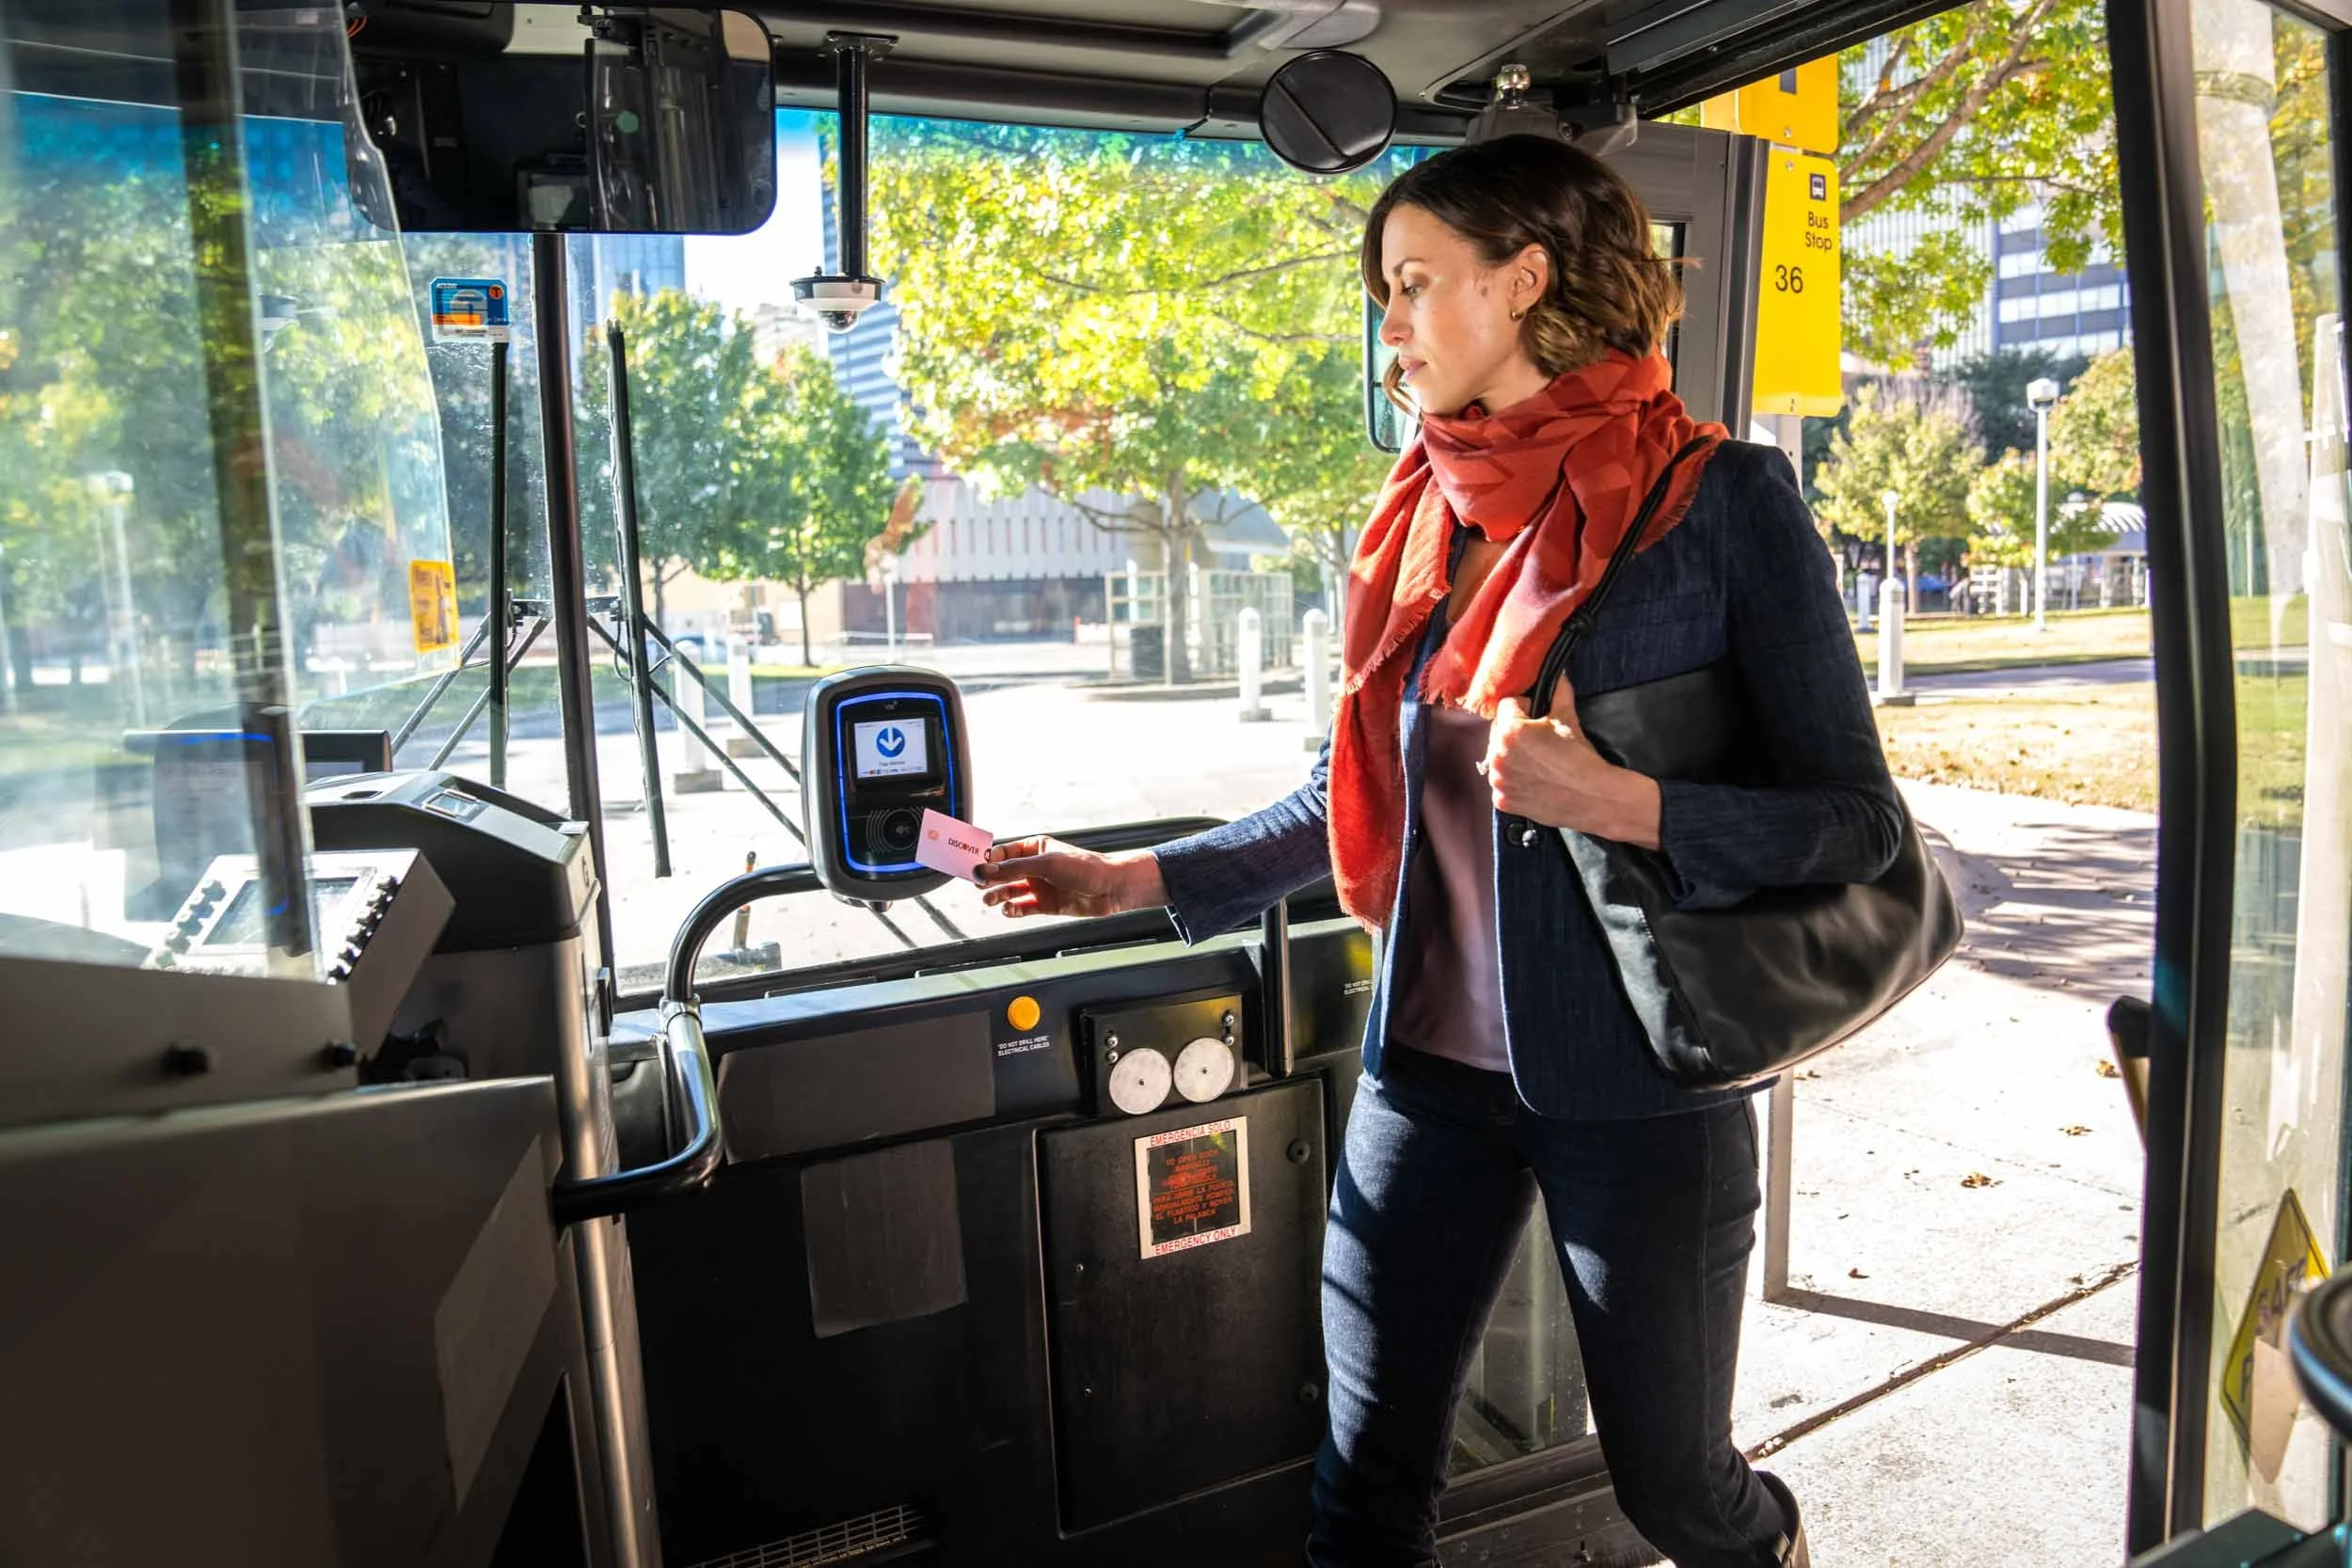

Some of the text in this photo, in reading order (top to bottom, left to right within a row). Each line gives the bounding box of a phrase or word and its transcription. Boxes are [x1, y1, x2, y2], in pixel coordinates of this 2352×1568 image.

[1807, 211, 1829, 229] Bus
[1805, 231, 1833, 252] Stop
[1775, 264, 1804, 293] 36
[948, 837, 980, 855] DISCOVER
[1029, 1041, 1050, 1051] CABLES
[1150, 1120, 1231, 1147] EMERGENCIA SOLO
[1154, 1226, 1236, 1256] EMERGENCY ONLY
